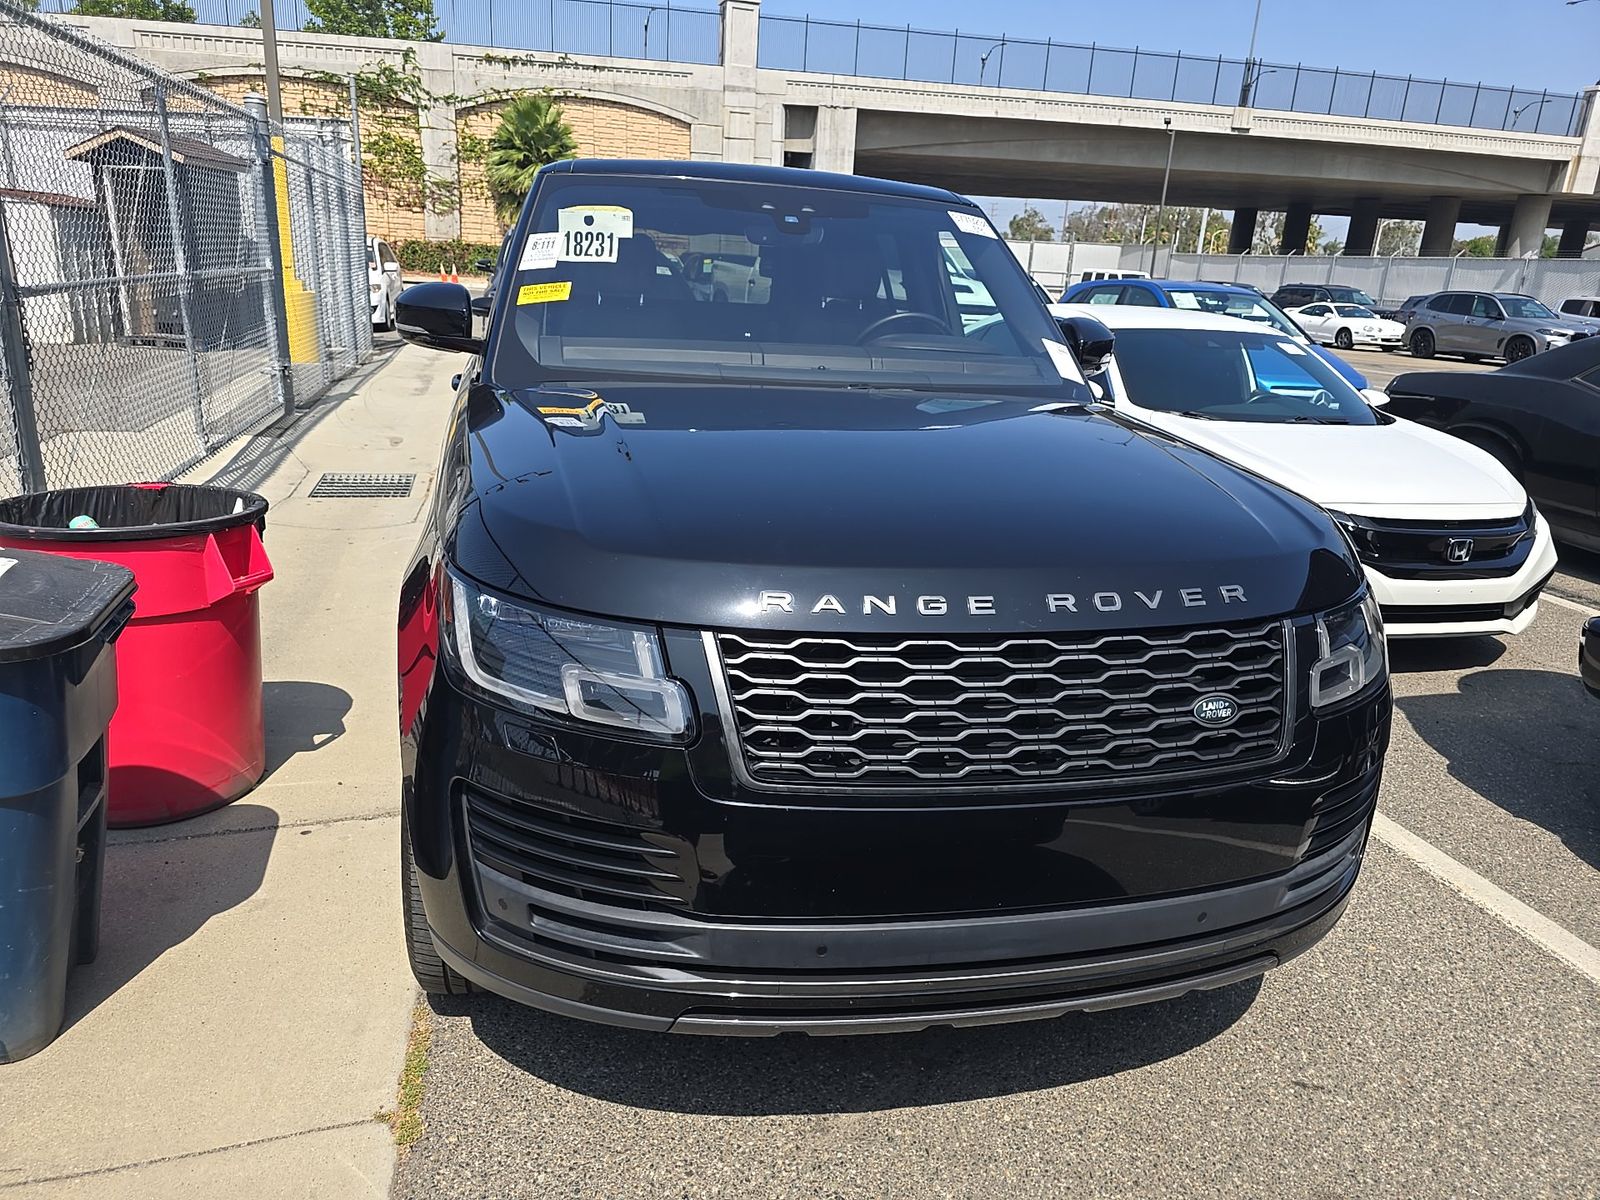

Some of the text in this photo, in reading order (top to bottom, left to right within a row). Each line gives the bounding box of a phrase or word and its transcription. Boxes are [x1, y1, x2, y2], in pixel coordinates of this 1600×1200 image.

[565, 231, 614, 257] 18231
[759, 584, 1248, 616] RANGE ROVER
[1202, 700, 1225, 711] LAND
[1206, 708, 1232, 719] ROVER
